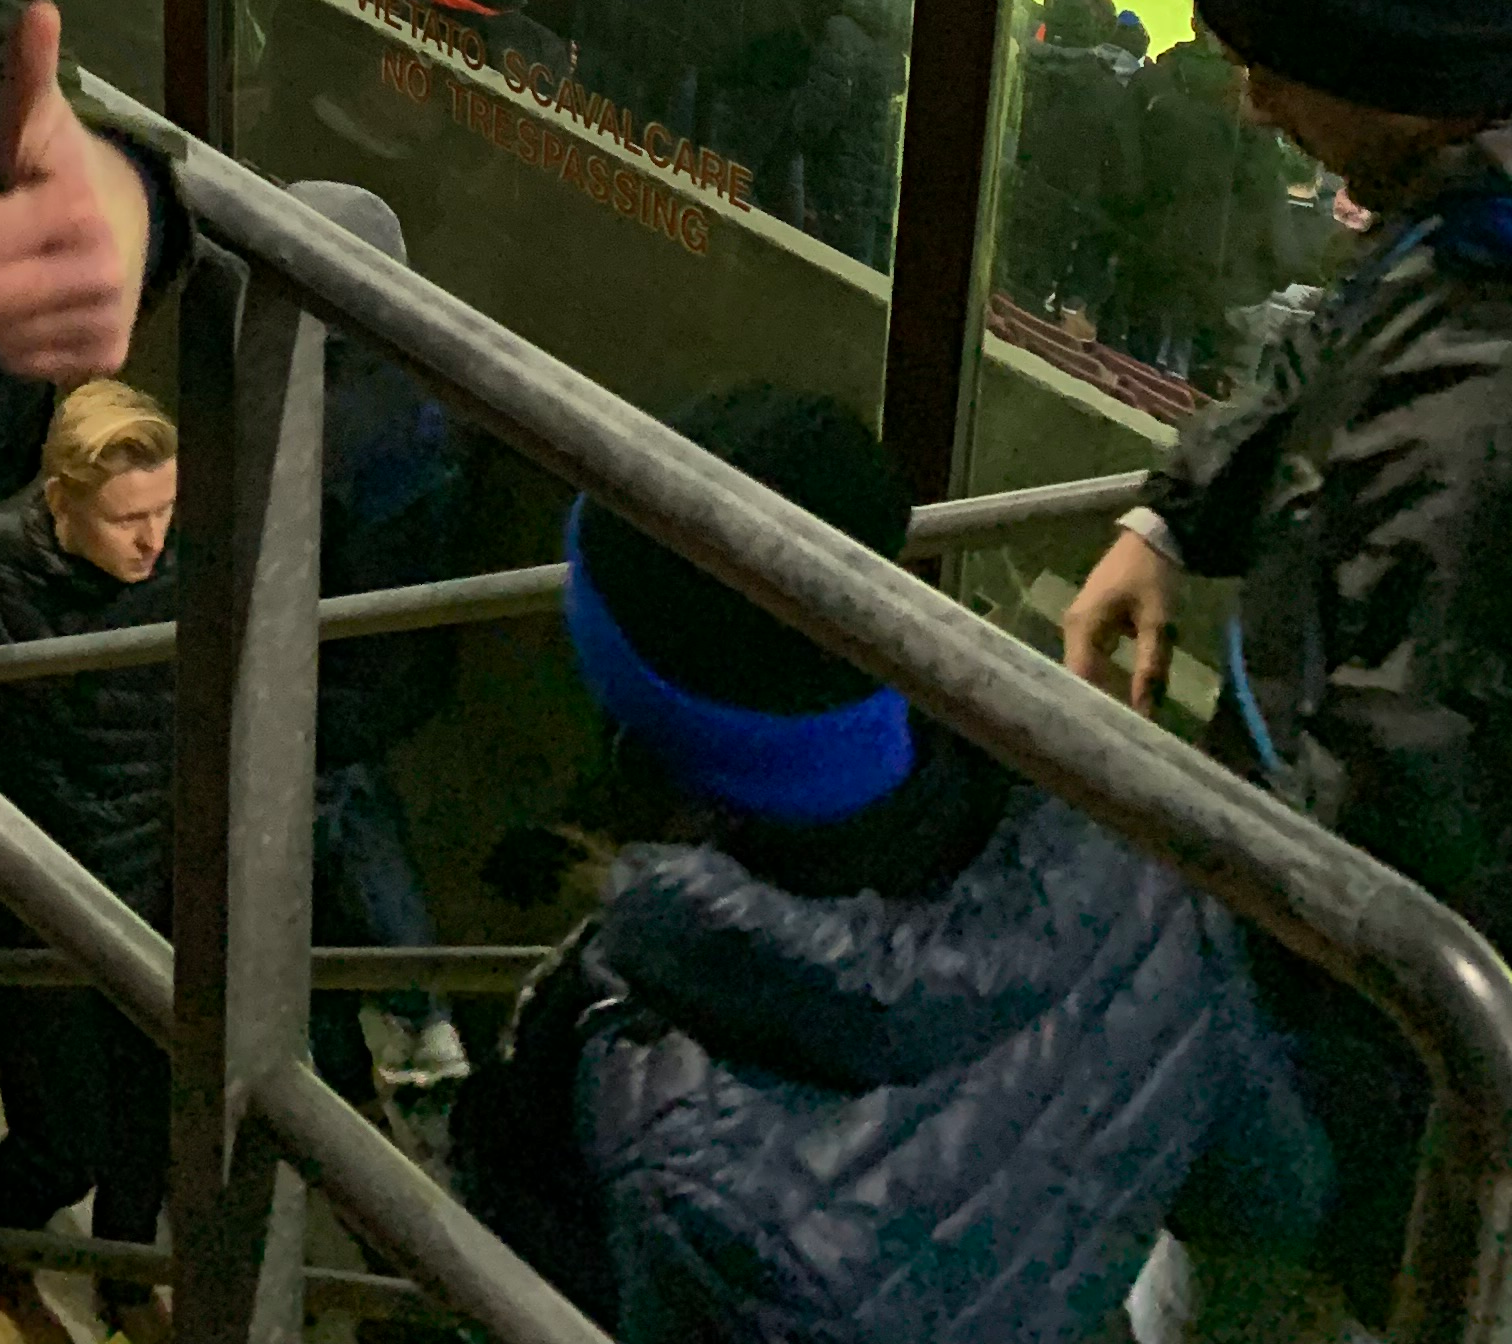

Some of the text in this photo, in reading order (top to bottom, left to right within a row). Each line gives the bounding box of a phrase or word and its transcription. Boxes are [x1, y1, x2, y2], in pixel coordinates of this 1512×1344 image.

[381, 52, 710, 257] NO TRESPASSING
[502, 47, 754, 213] SCAVALCARE
